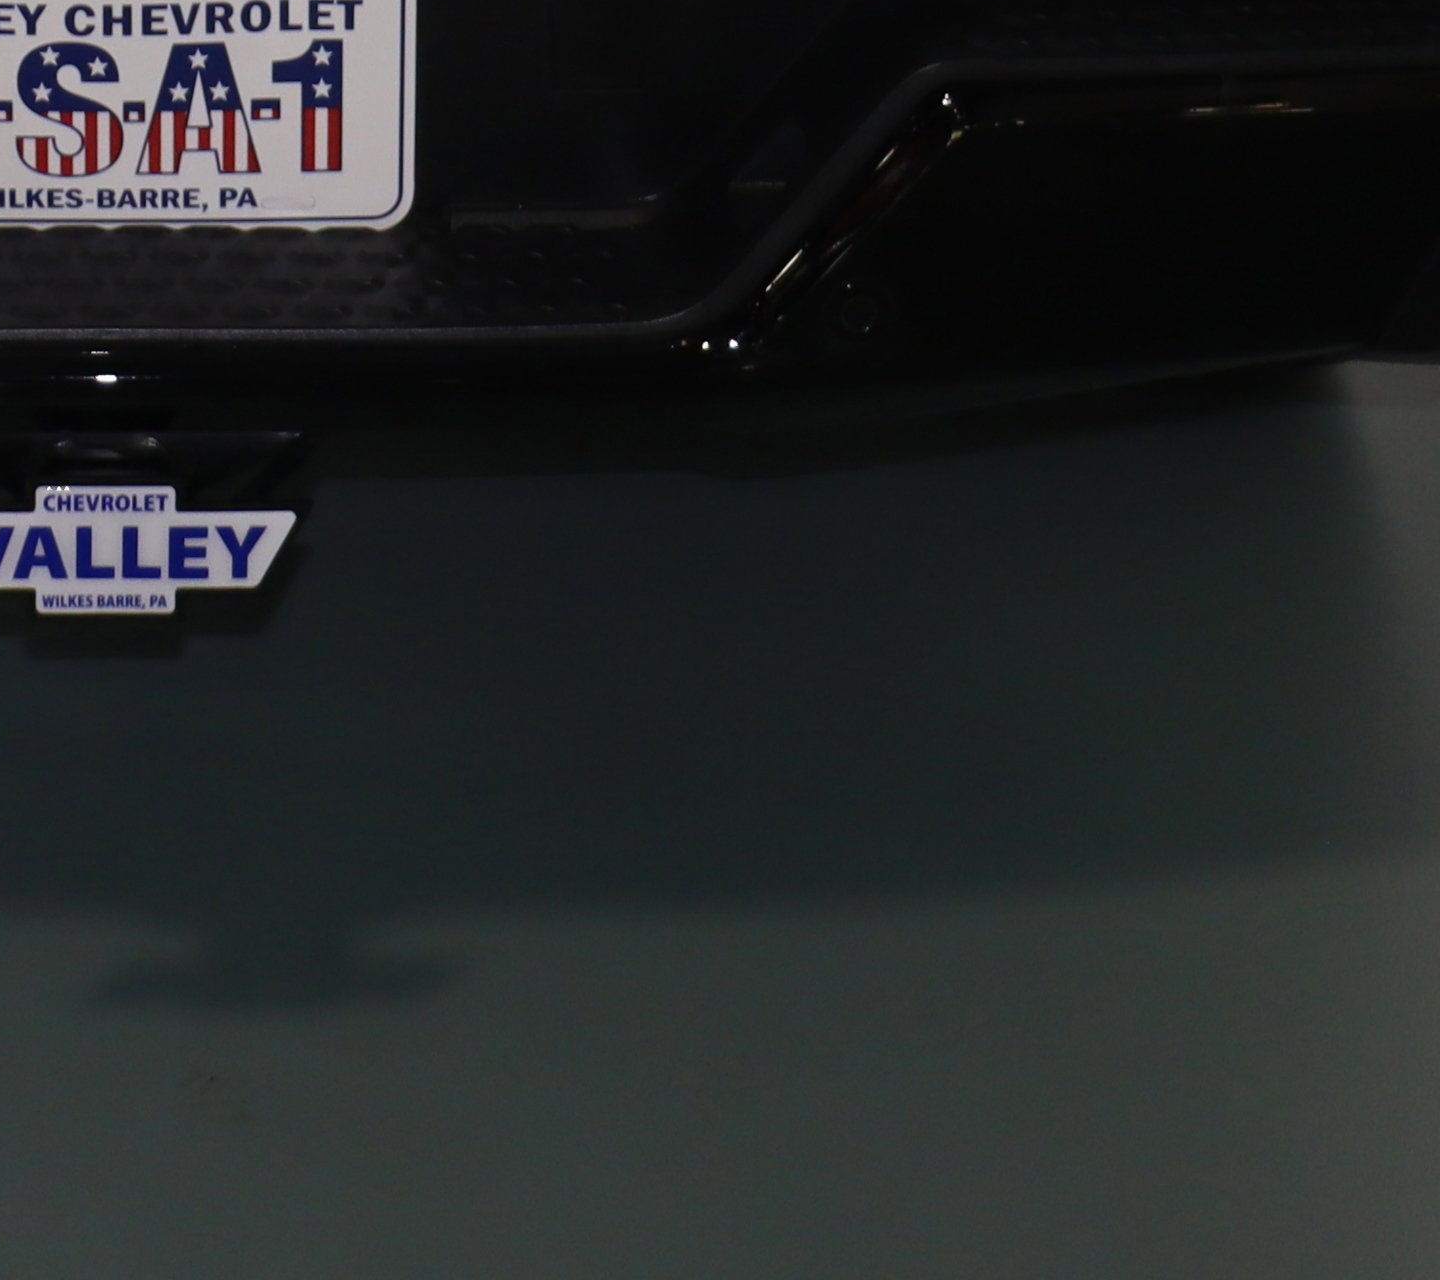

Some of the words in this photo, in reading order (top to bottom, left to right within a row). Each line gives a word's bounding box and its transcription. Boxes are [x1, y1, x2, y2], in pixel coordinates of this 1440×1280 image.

[219, 188, 258, 209] PA
[43, 493, 169, 513] CHEVROLET
[42, 594, 93, 609] WILKES
[96, 594, 146, 610] BARRE,
[149, 594, 168, 609] PA
